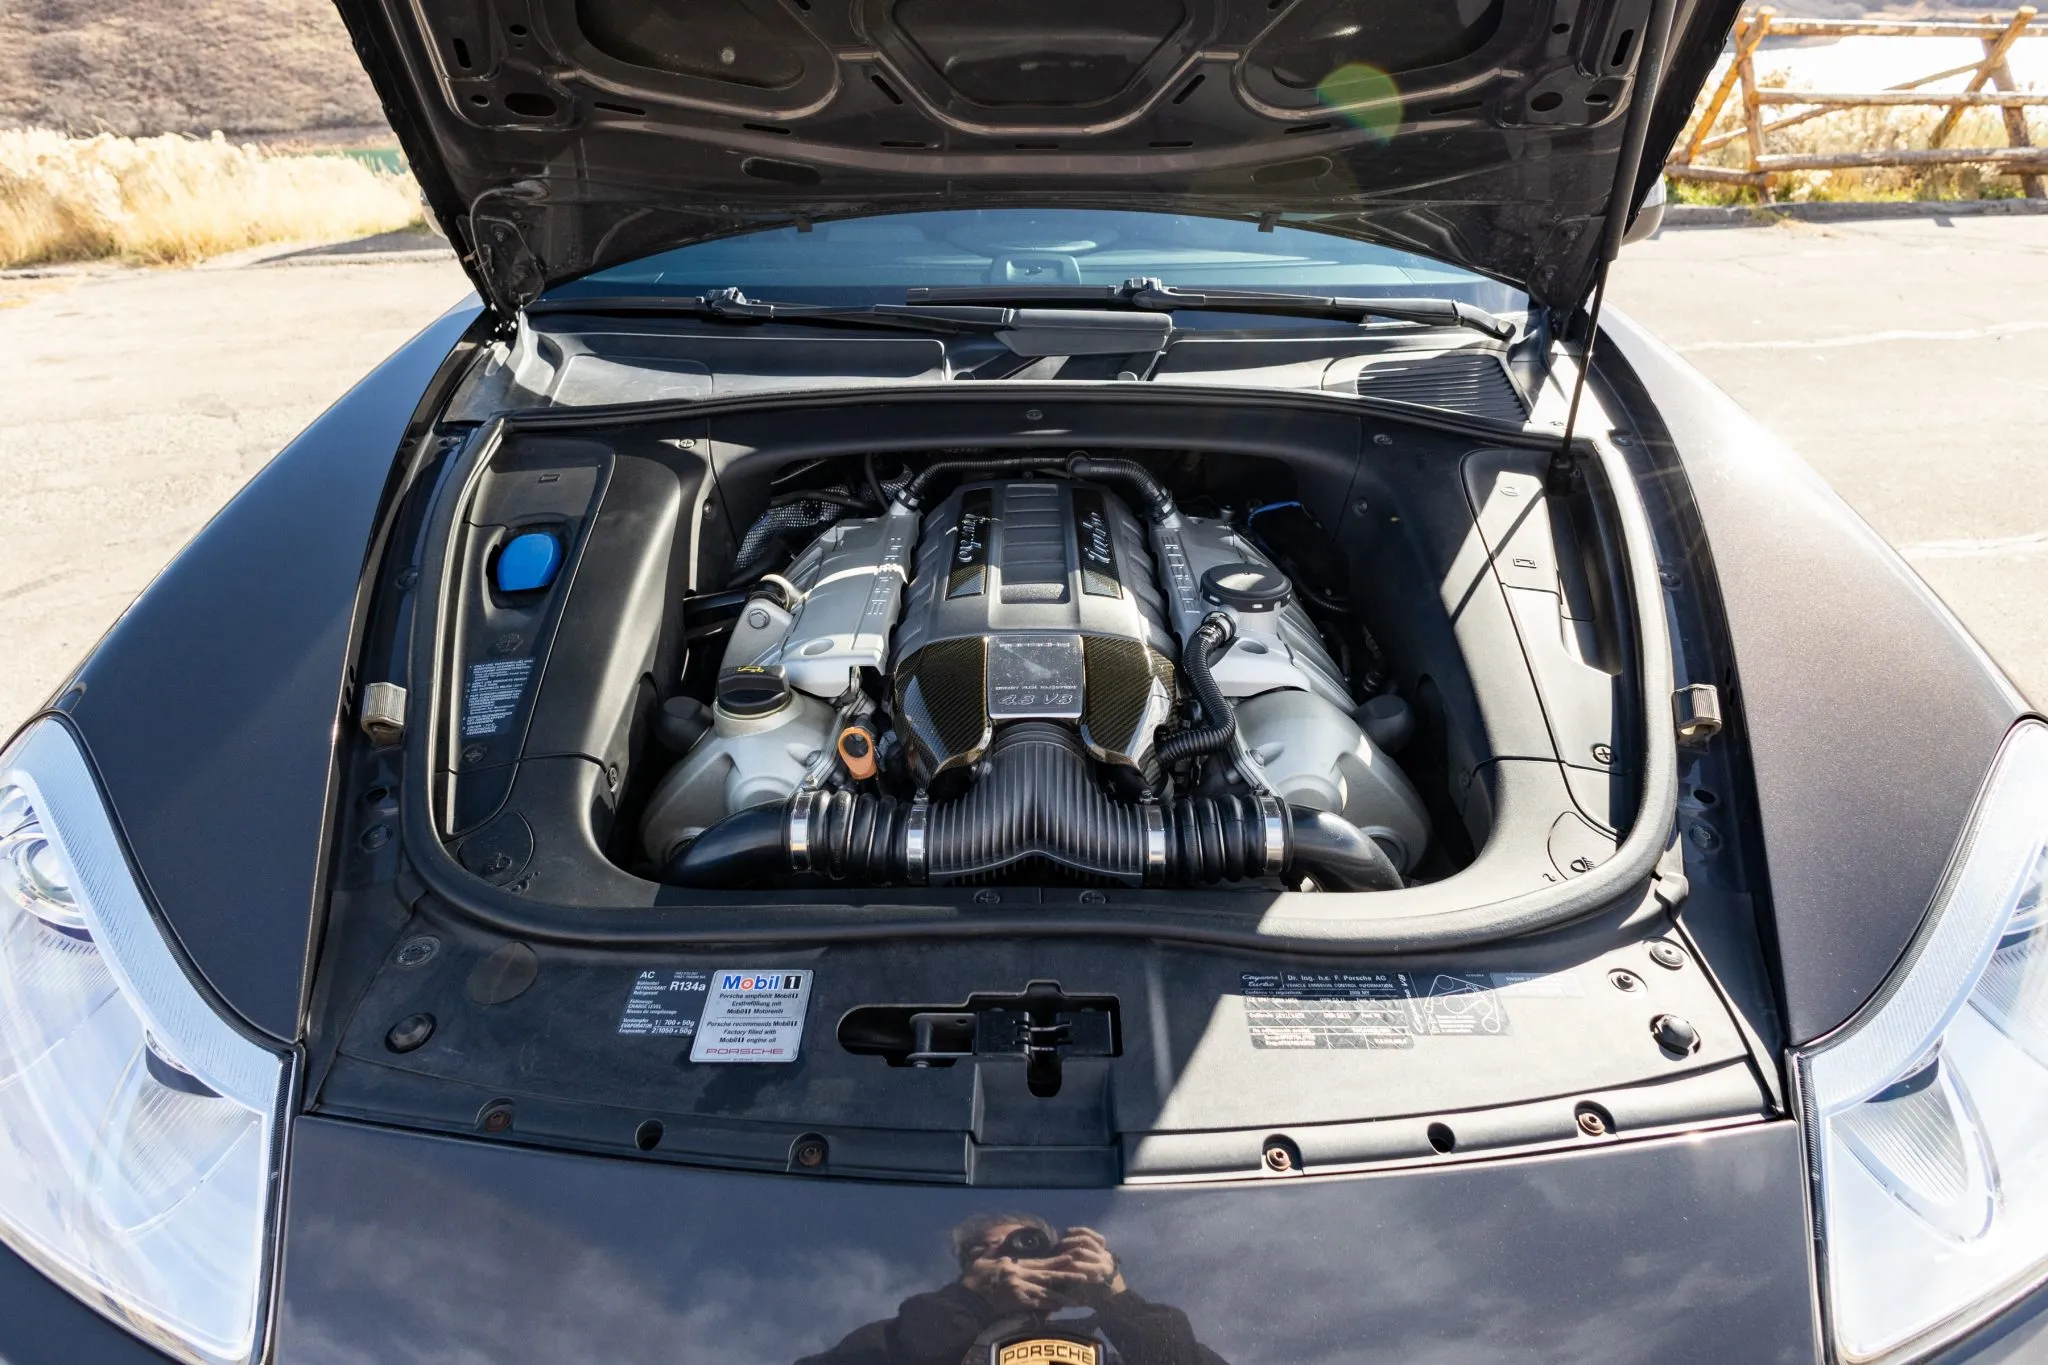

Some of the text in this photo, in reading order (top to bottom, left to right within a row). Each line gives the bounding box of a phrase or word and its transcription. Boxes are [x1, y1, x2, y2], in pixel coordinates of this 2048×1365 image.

[998, 693, 1073, 705] 4.8 V8
[722, 975, 780, 990] Mobil
[1242, 974, 1279, 982] Cayenne
[669, 981, 706, 991] R134a
[1003, 1344, 1094, 1364] PORSCHE
